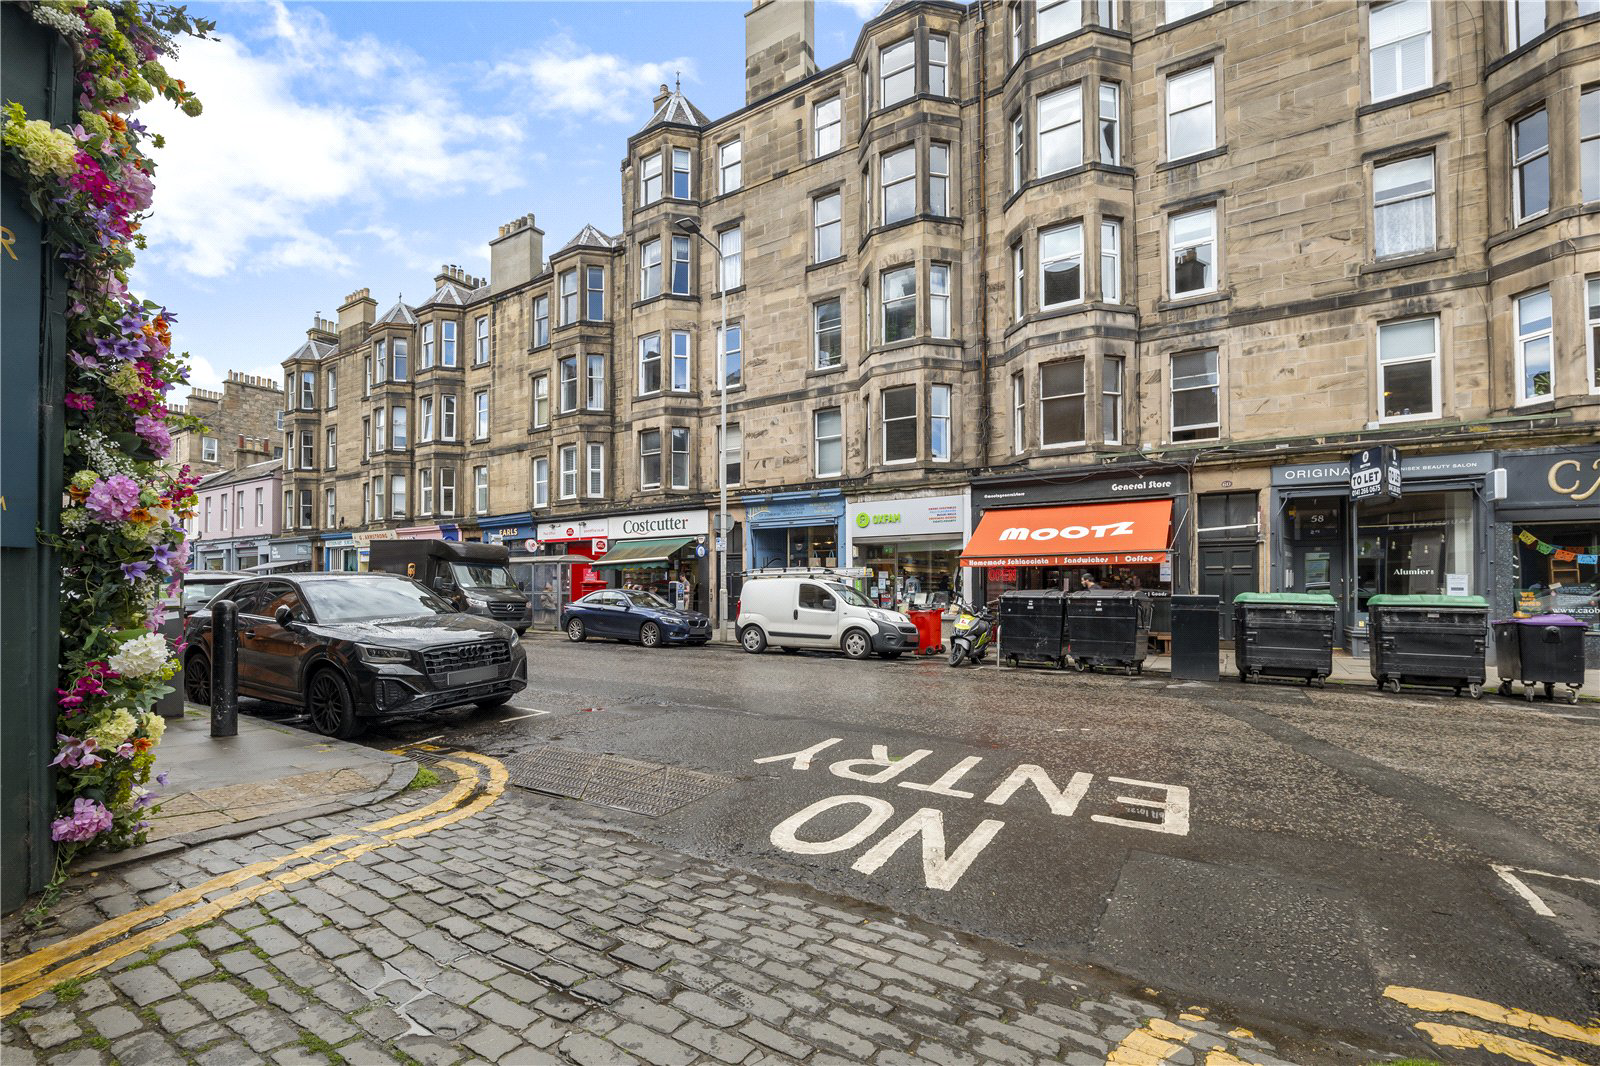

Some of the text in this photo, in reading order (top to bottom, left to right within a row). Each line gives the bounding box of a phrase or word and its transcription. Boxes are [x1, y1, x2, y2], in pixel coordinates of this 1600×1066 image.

[1352, 471, 1379, 487] TO LET
[1111, 480, 1172, 491] General Store
[872, 512, 901, 525] OXFAM
[1311, 514, 1324, 523] 58
[499, 527, 518, 536] EARLS
[623, 517, 689, 534] Costcutter
[998, 521, 1136, 541] MOOTZ
[365, 532, 388, 540] ARMSTRONG
[1063, 556, 1109, 564] Sandwiches
[988, 569, 1016, 581] OPEN
[753, 737, 1190, 836] ENTRY
[770, 794, 1005, 892] NO
